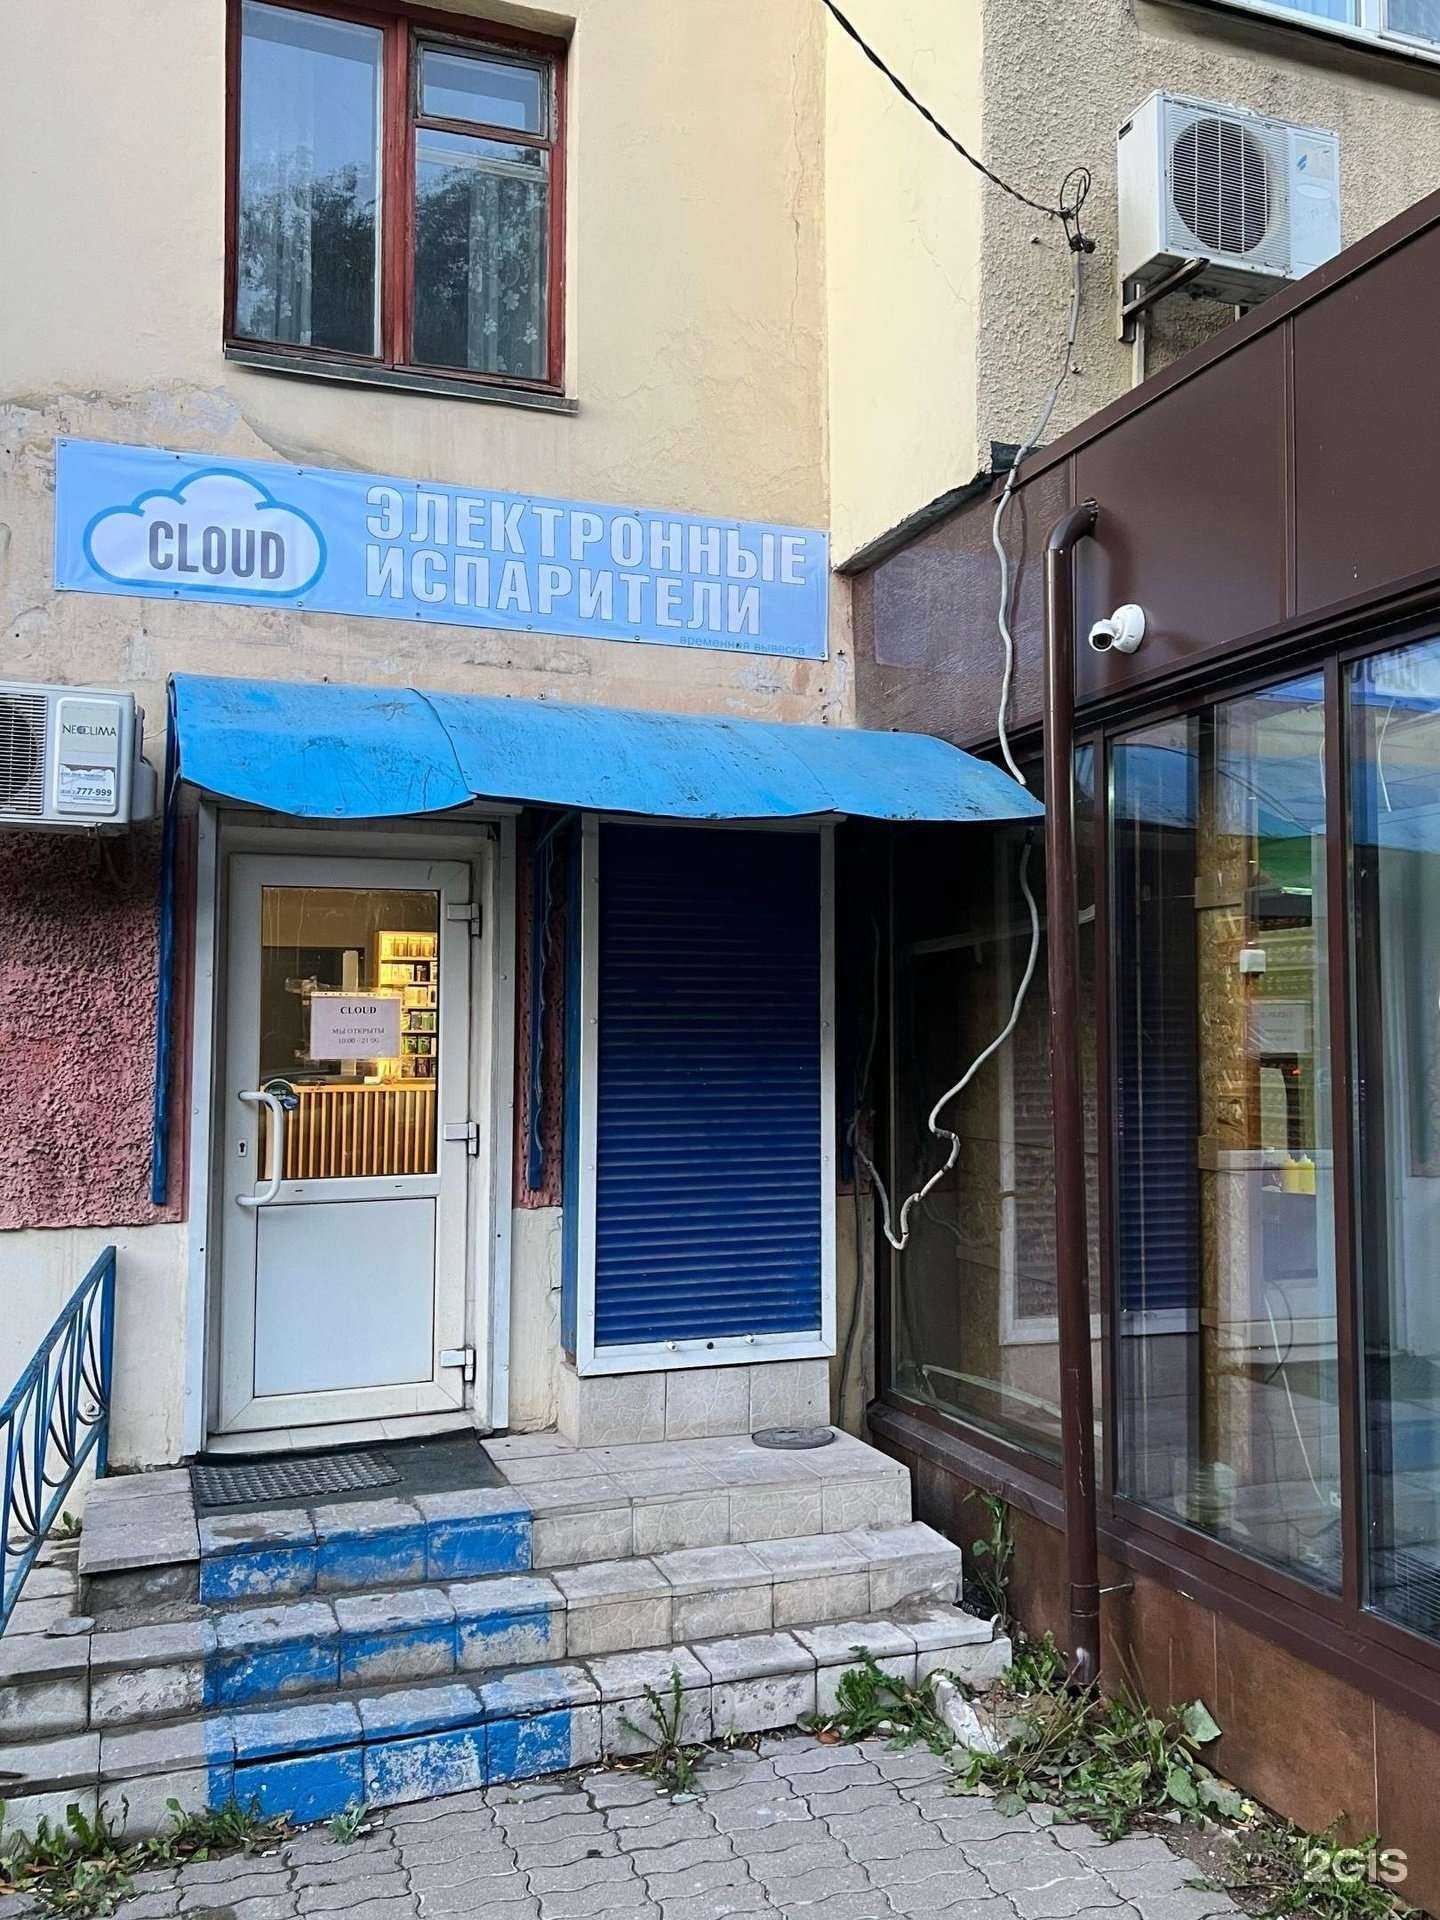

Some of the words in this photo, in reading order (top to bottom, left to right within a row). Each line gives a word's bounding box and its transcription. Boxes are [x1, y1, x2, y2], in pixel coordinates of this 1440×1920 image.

[149, 520, 285, 579] CLOUD
[366, 485, 806, 585] ЭЛЕКТРОННЫЕ
[365, 543, 760, 635] ИСПАРИТЕЛИ
[340, 1006, 377, 1015] CLOUD
